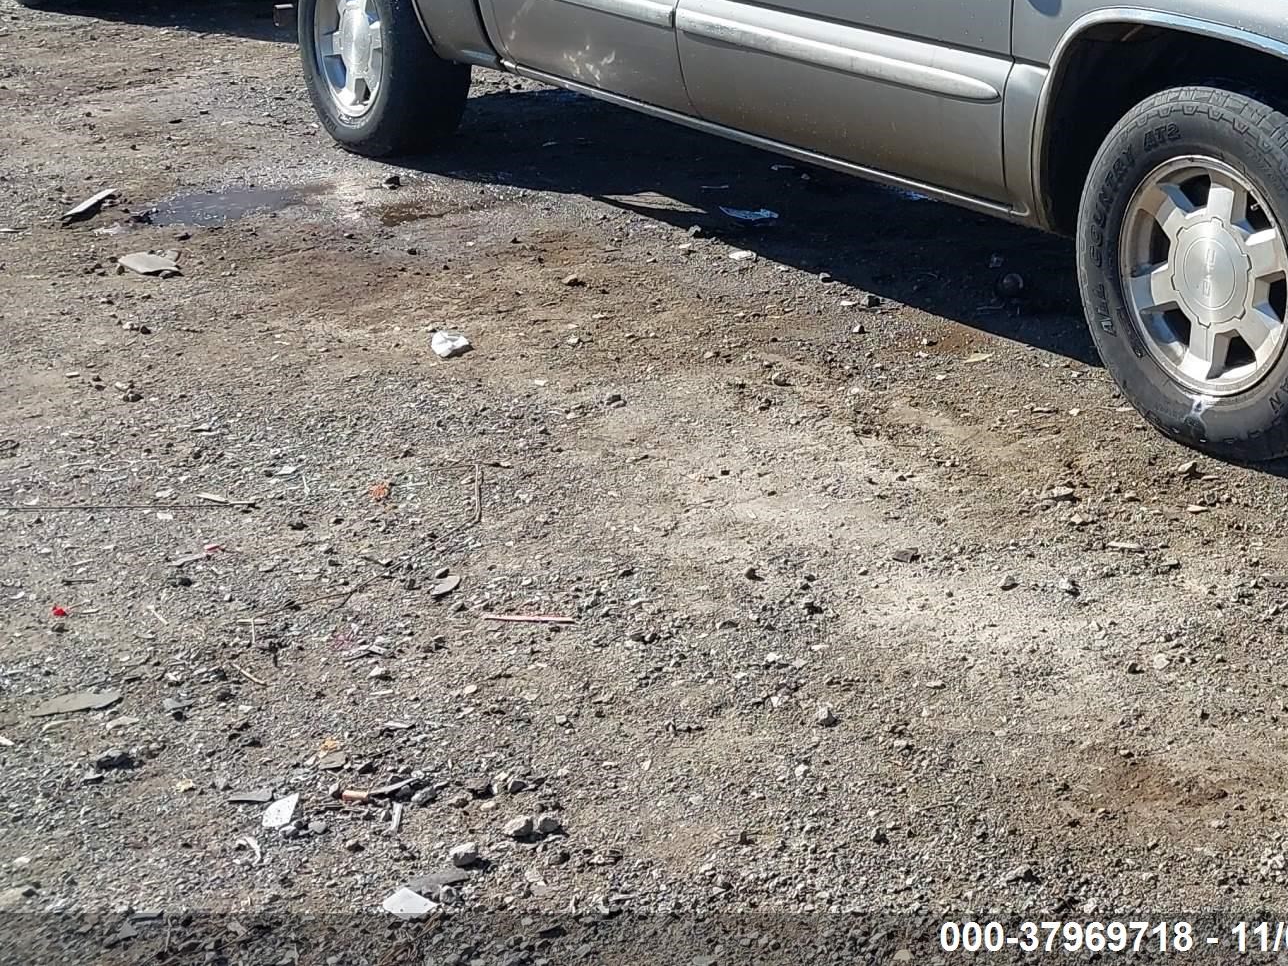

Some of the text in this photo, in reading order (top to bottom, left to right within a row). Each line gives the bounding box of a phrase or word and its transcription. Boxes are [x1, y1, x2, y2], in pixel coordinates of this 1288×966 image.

[1089, 123, 1181, 338] ALL COUNTRY AT2
